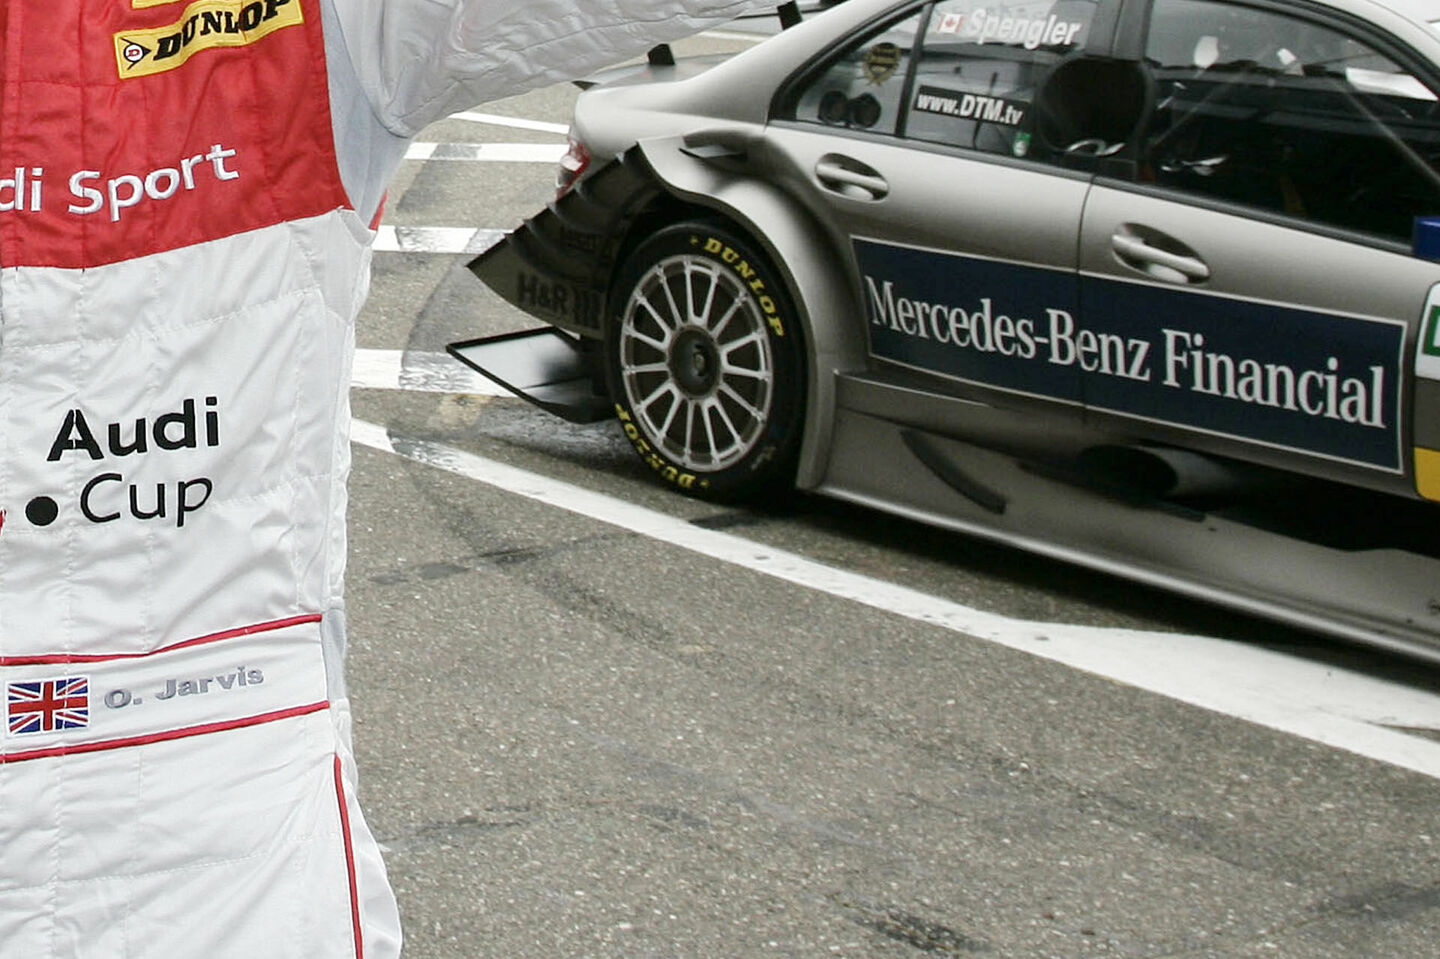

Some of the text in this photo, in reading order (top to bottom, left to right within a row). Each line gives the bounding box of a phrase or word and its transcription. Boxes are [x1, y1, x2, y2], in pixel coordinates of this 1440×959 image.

[968, 8, 1083, 49] Spengler
[916, 91, 1023, 126] www.DTM.tv
[67, 143, 240, 222] Sport
[703, 237, 784, 337] DUNLOP
[865, 275, 1152, 382] Mercedes-Benz
[1162, 328, 1386, 429] Financial
[46, 396, 221, 461] Audi
[79, 472, 214, 528] Cup
[104, 666, 264, 709] O. Jarvis
